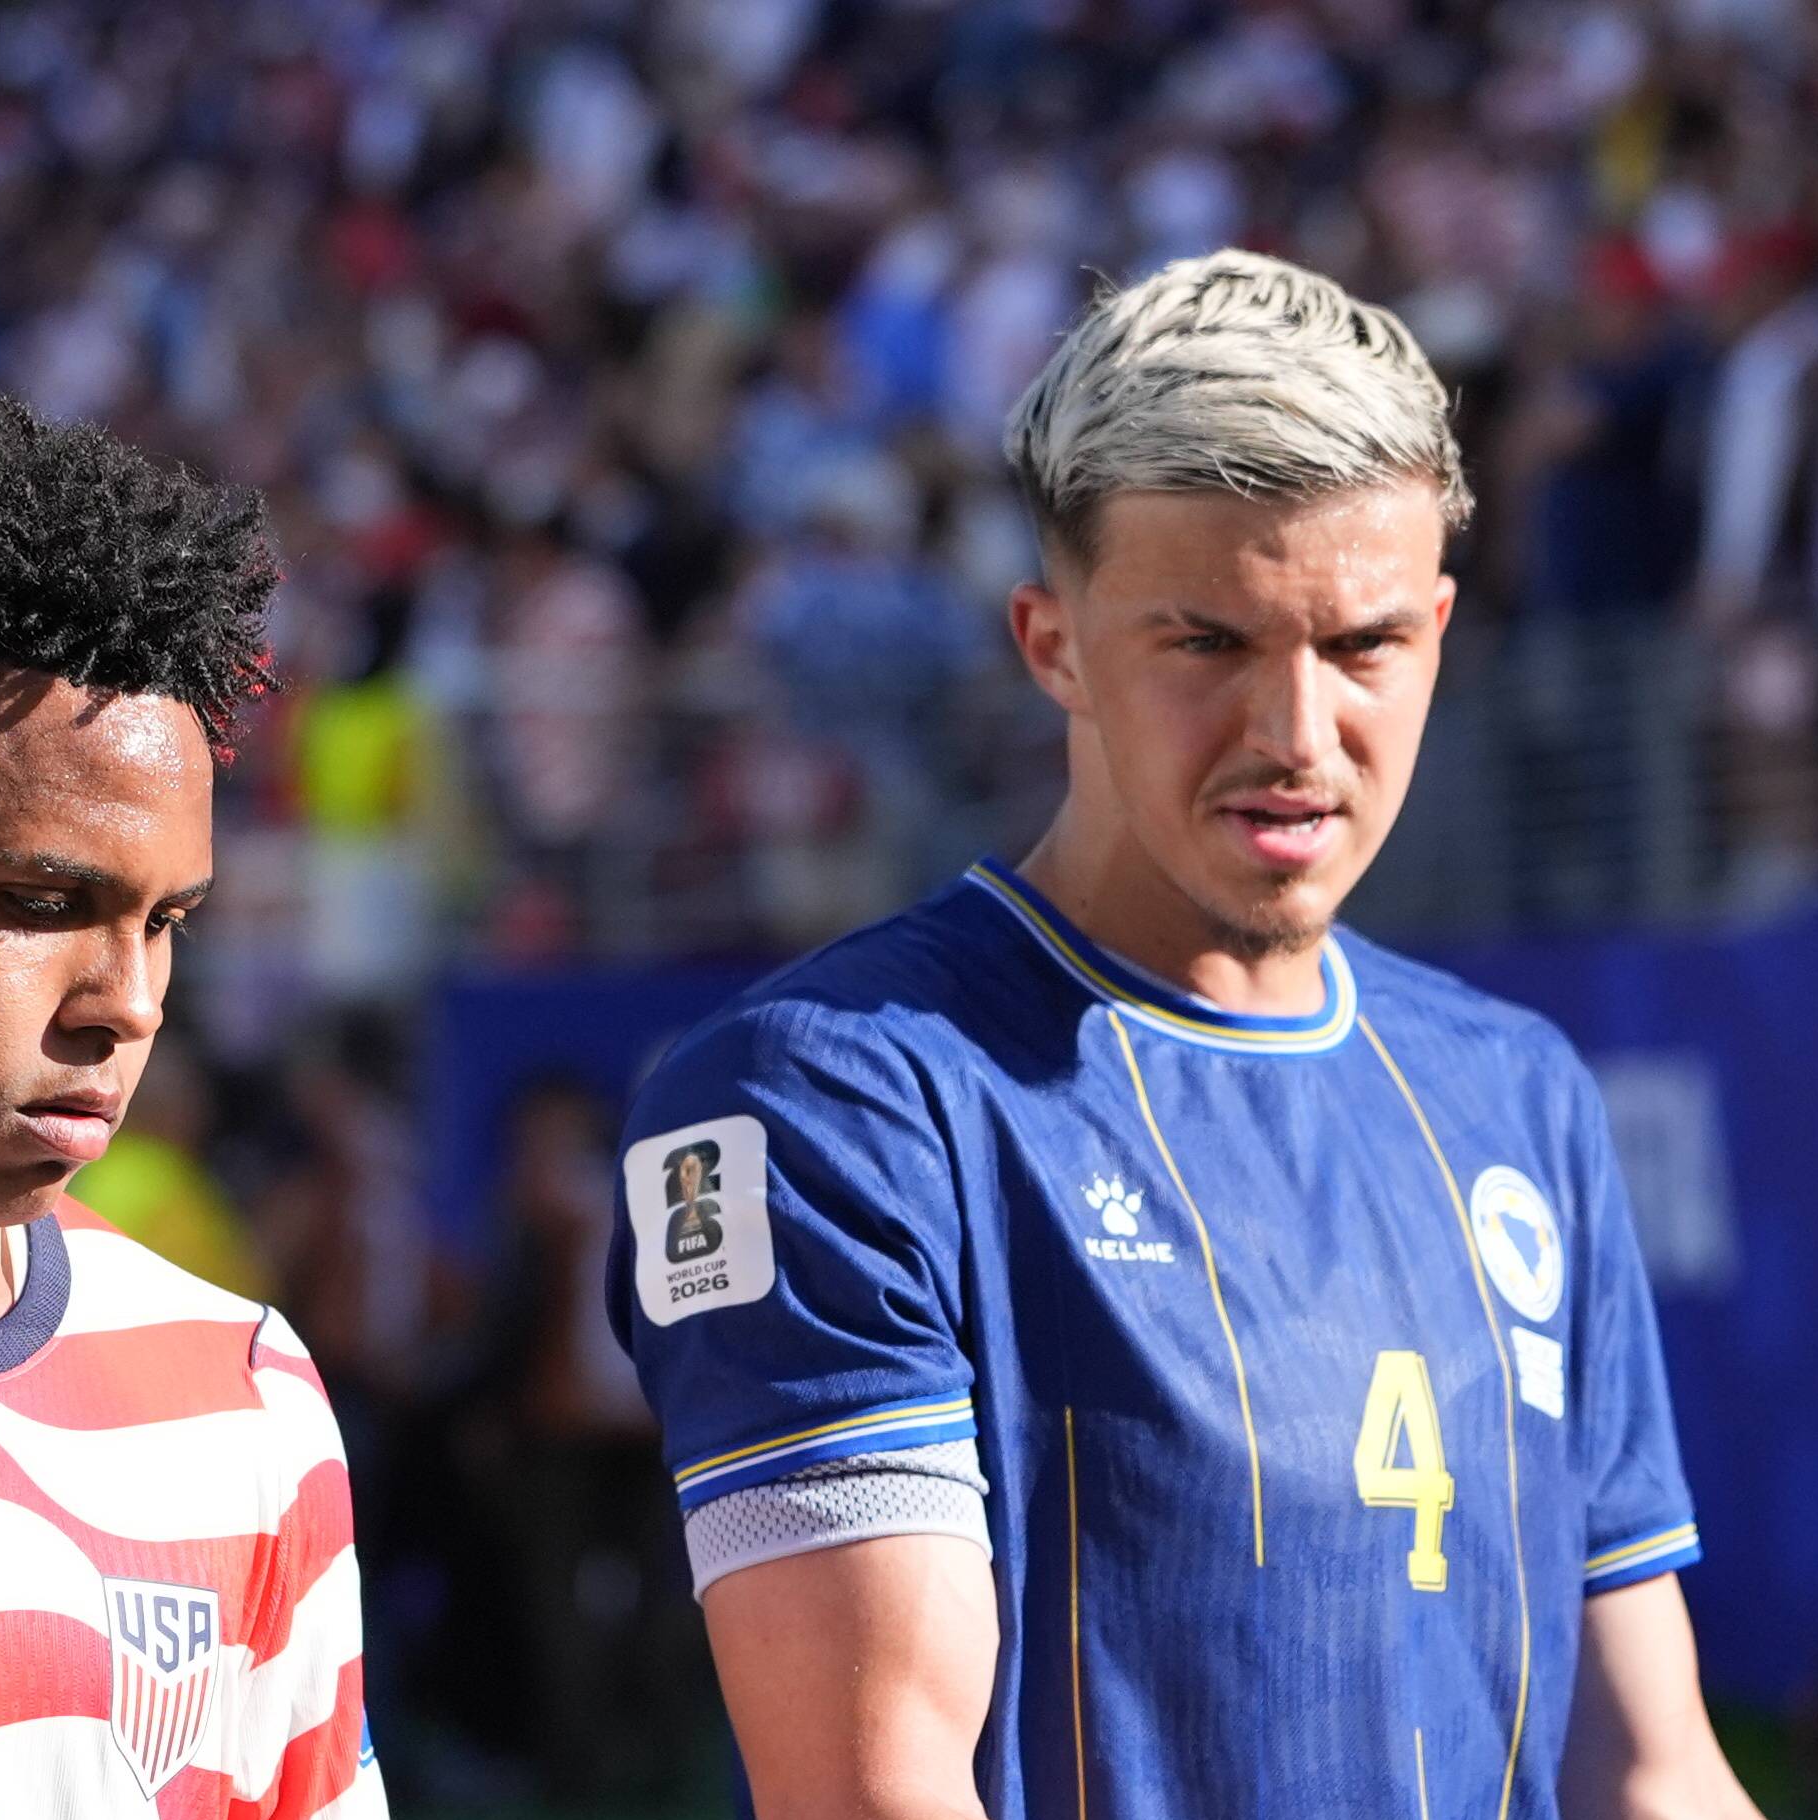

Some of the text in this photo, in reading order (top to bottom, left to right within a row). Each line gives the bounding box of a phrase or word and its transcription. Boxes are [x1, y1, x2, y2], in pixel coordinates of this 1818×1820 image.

[678, 1234, 707, 1254] FIFA
[1084, 1236, 1176, 1264] KELME
[666, 1259, 727, 1284] WORLD CUP
[670, 1273, 730, 1304] 2026
[1353, 1349, 1455, 1592] 4
[115, 1590, 212, 1675] USA
